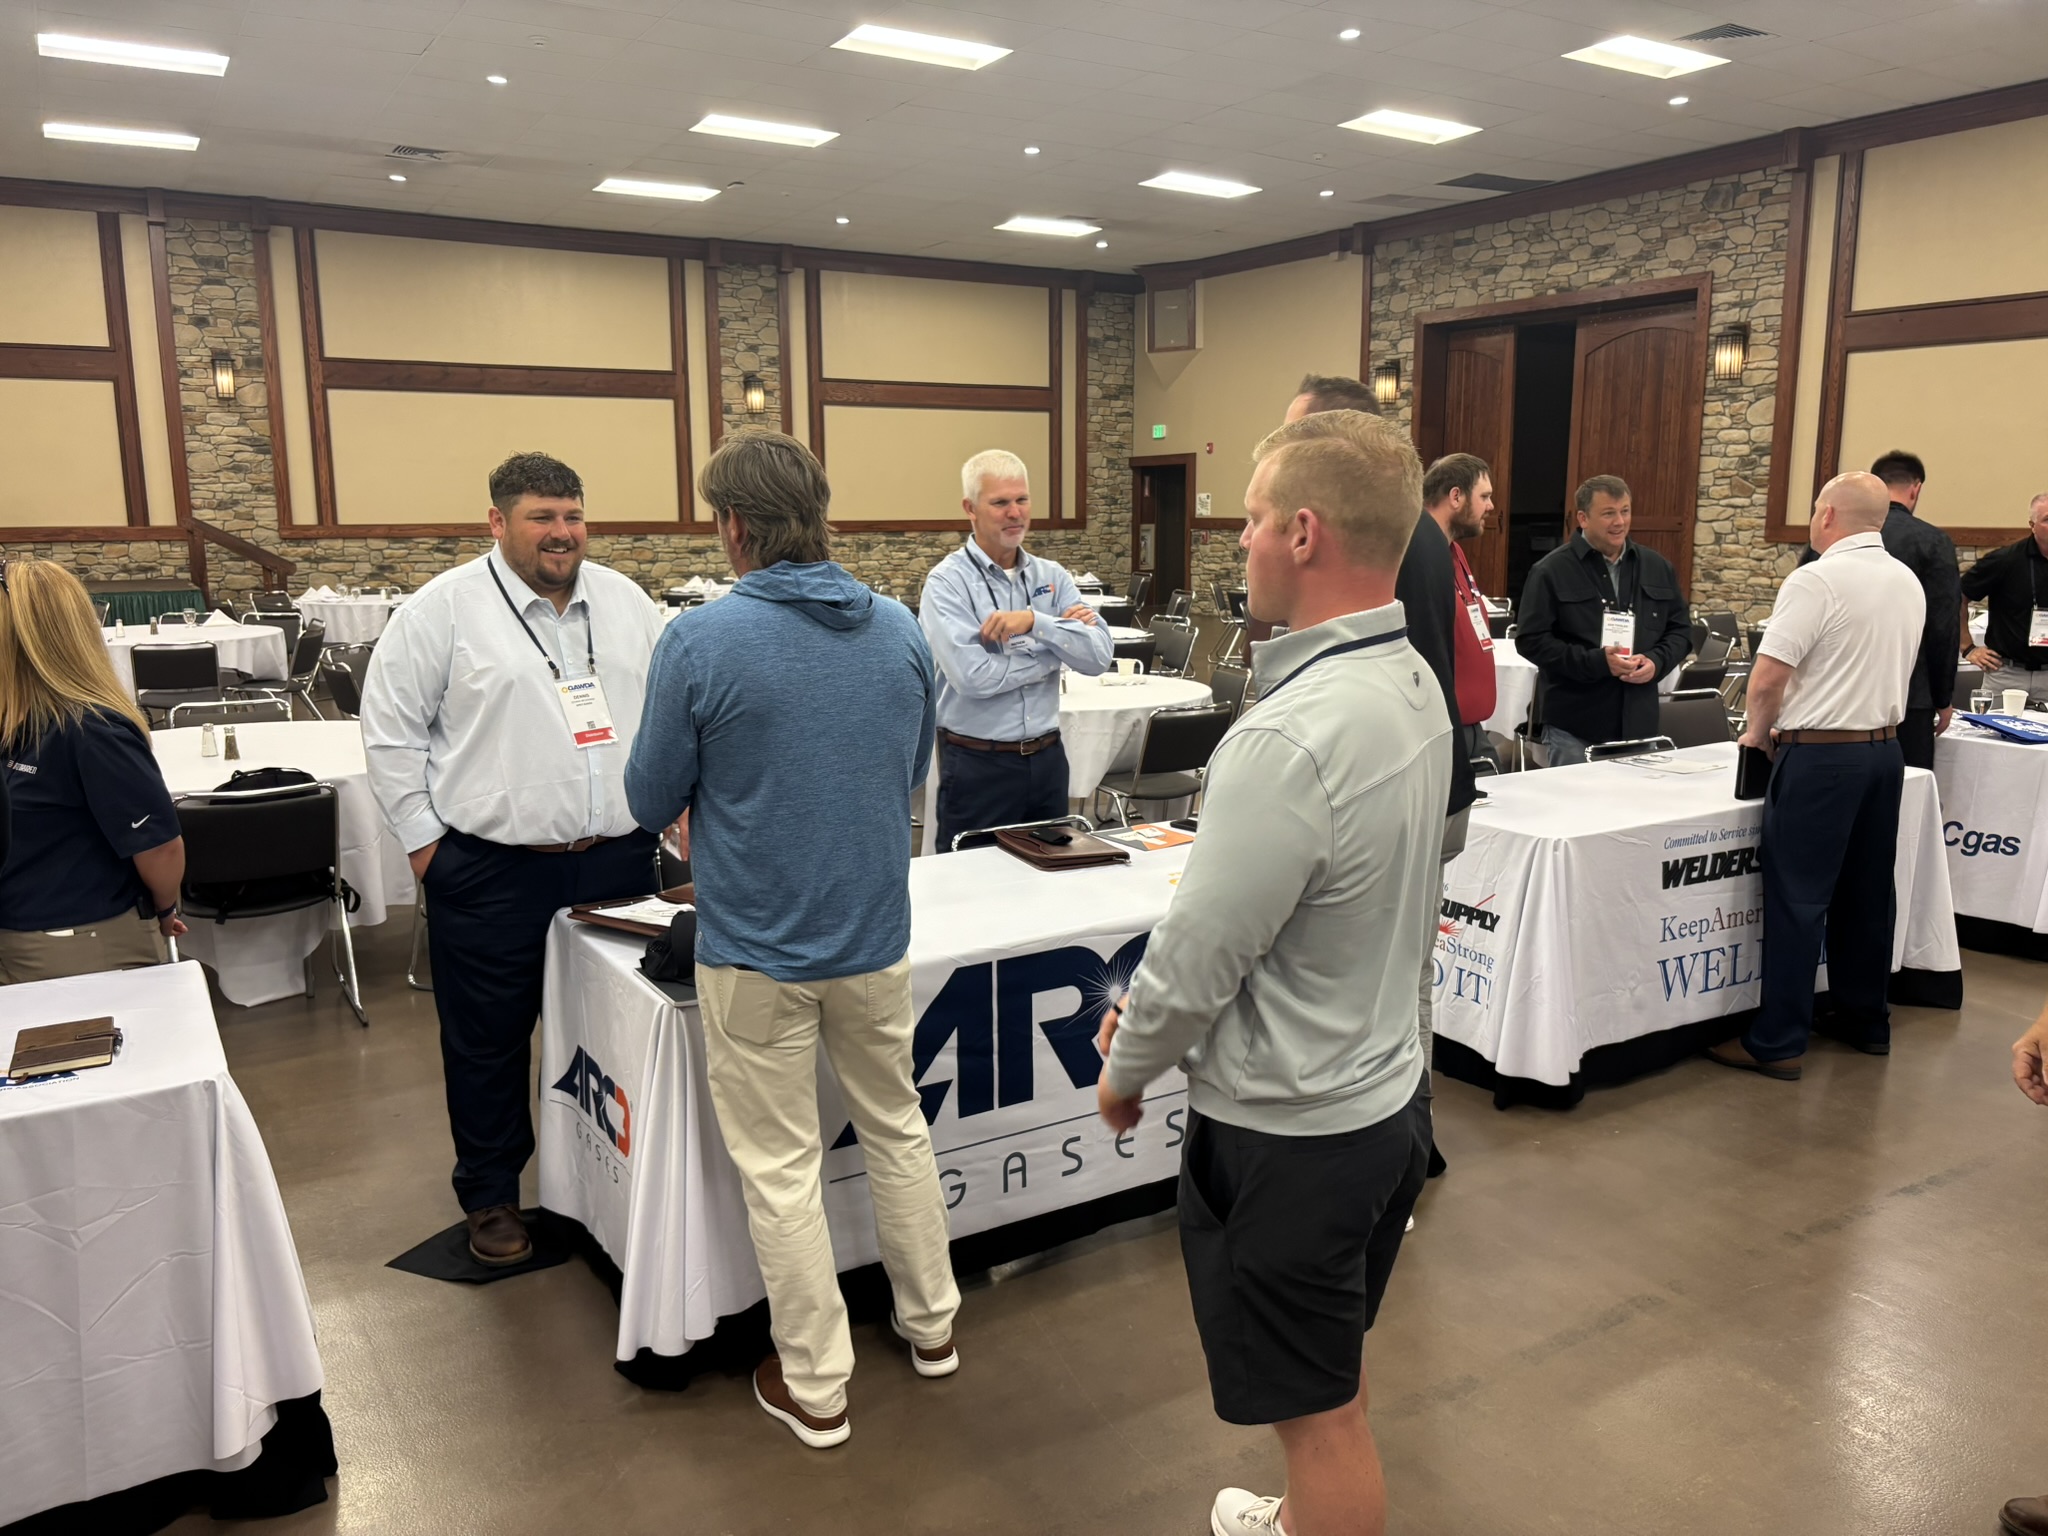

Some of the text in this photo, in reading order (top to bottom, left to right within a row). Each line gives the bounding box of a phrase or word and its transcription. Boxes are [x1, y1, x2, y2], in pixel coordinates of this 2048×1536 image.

[1664, 830, 1708, 849] Committed
[1709, 830, 1718, 842] to
[1719, 826, 1747, 841] Service
[1440, 898, 1501, 933] UPPLY
[1659, 906, 1763, 943] KeepAmer
[576, 1121, 619, 1184] GASES
[938, 1108, 1185, 1210] GASES
